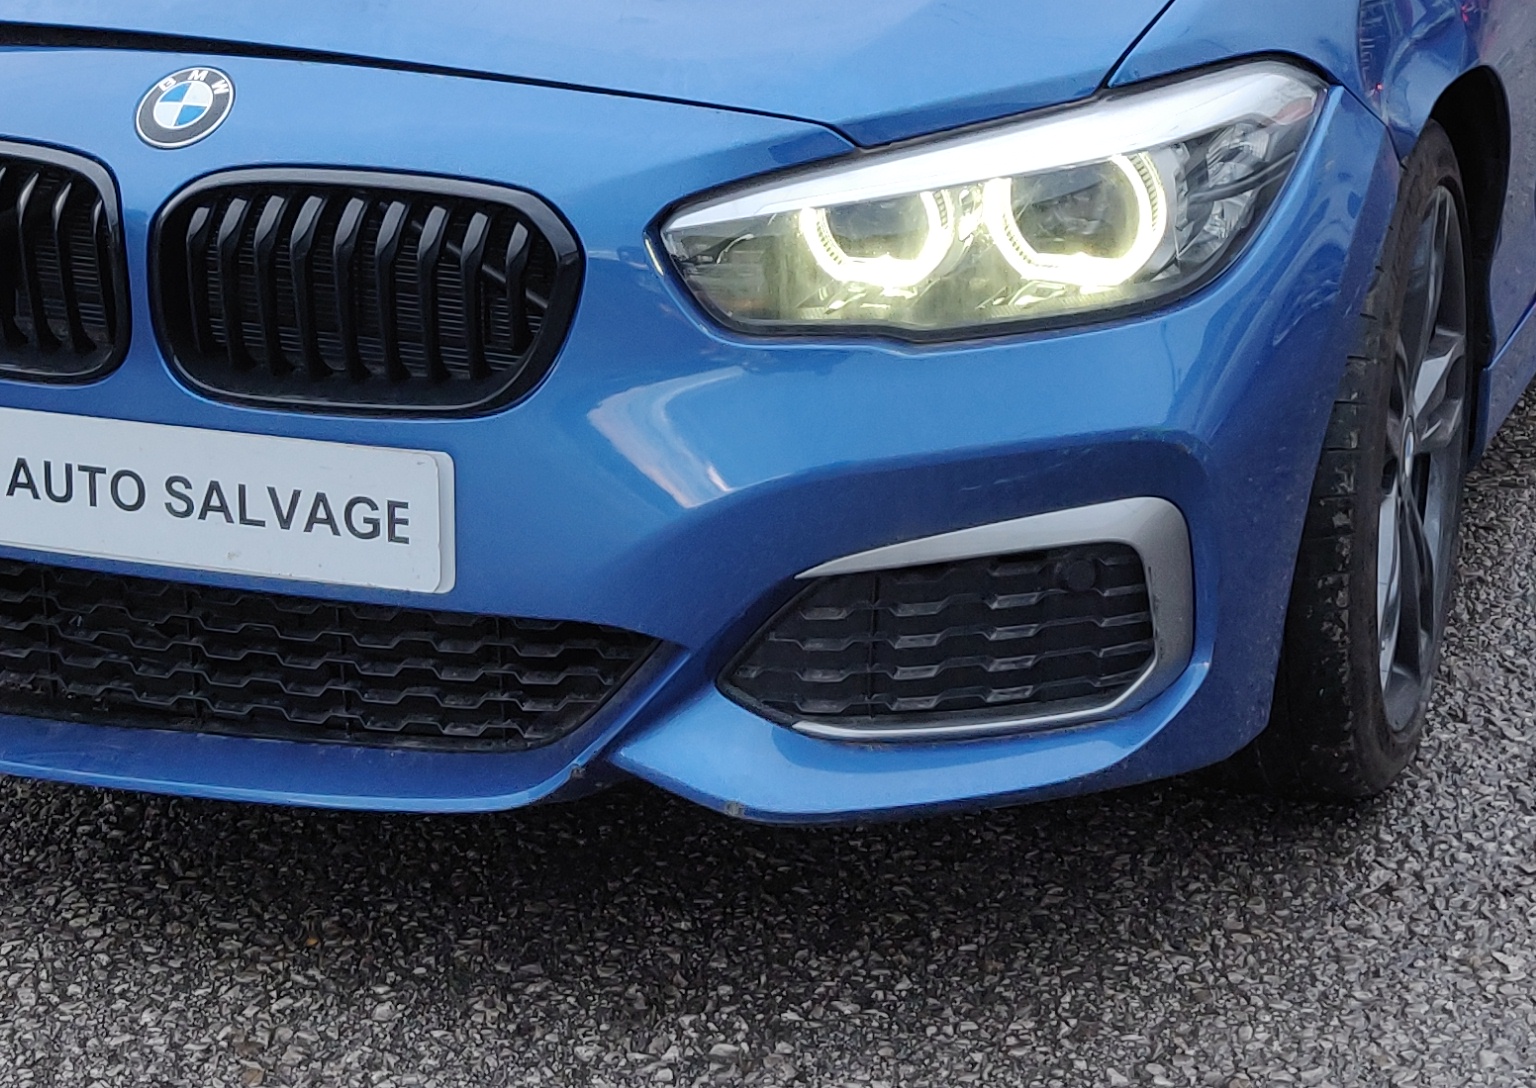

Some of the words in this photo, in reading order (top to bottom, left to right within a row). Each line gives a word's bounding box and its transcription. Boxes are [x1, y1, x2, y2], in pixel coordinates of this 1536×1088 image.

[158, 69, 230, 95] BMW
[6, 457, 146, 512] AUTO
[164, 475, 410, 544] SALVAGE
